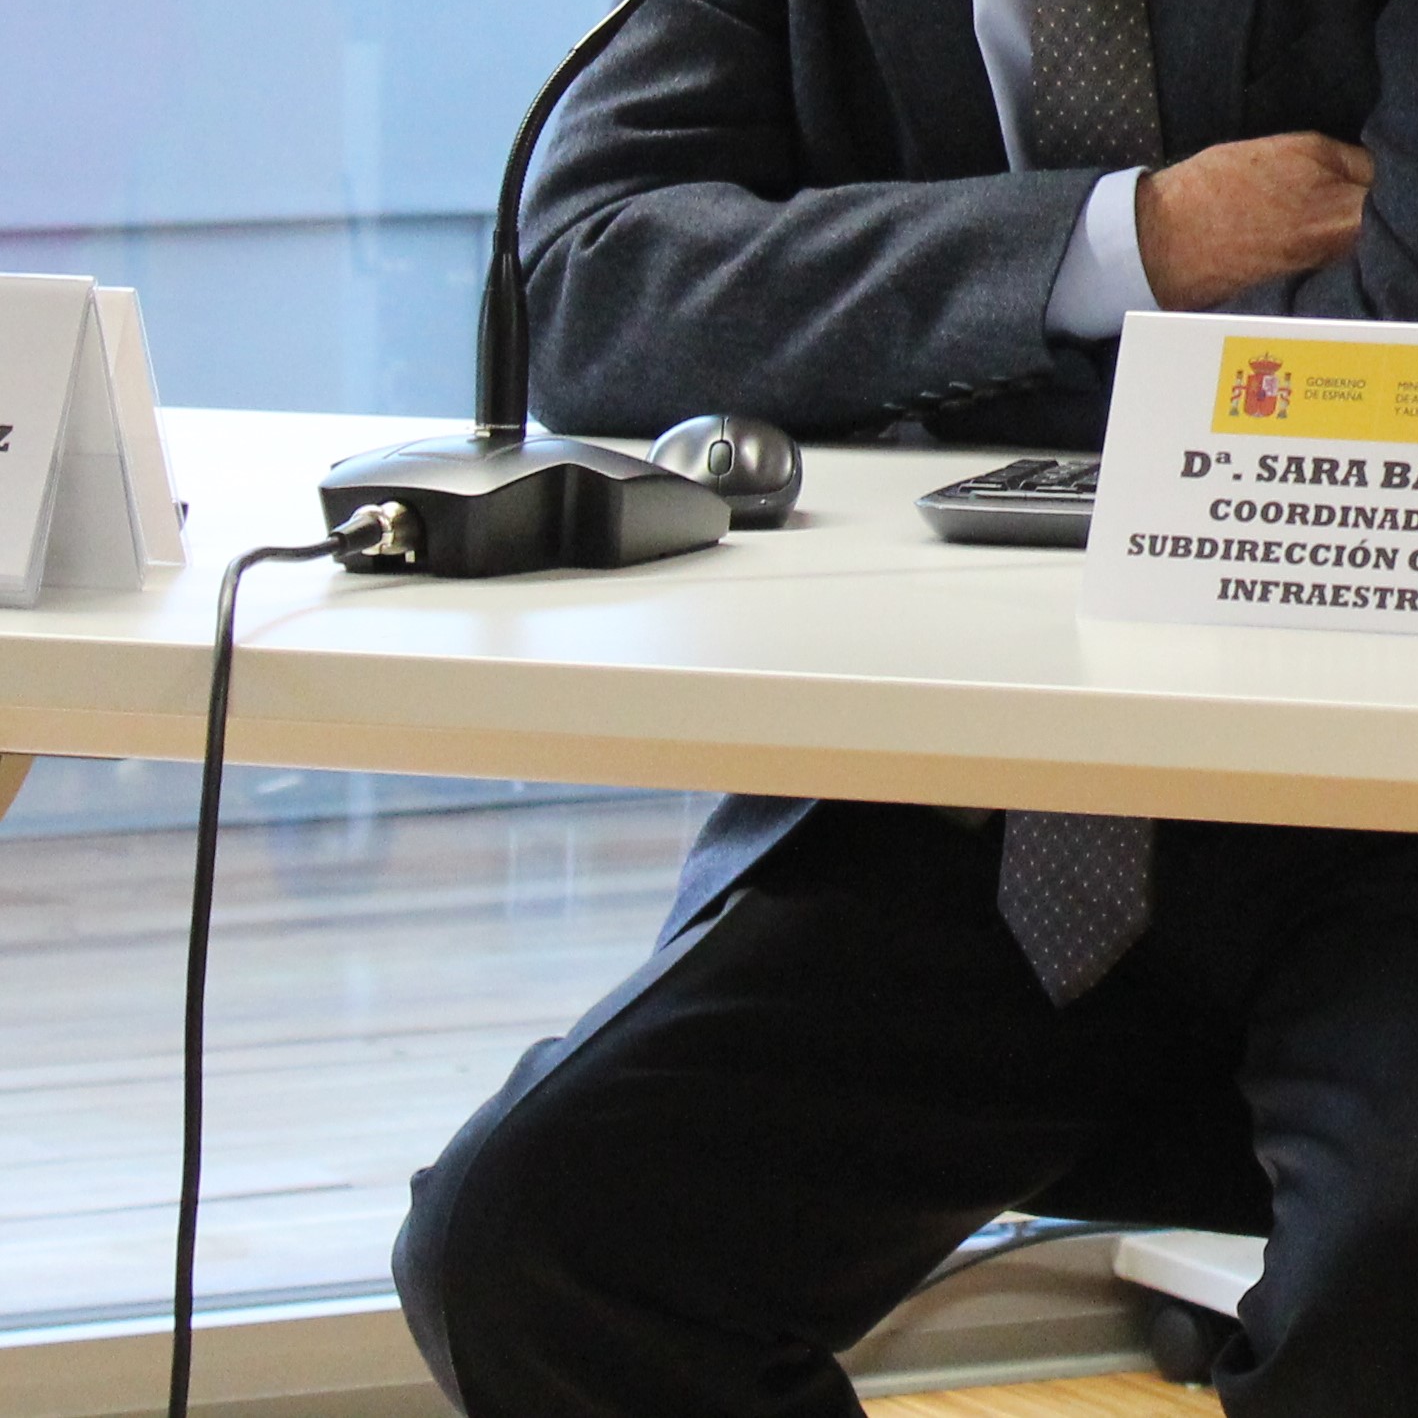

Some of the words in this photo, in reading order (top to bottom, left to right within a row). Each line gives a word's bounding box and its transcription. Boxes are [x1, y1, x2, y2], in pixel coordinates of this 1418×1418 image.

[1306, 377, 1366, 389] GOBIERNO
[1304, 390, 1319, 400] DE
[1322, 390, 1363, 401] ESPAÑA
[1395, 394, 1411, 404] DE
[1395, 408, 1401, 416] Y
[1256, 454, 1369, 488] SARA
[1127, 533, 1400, 571] SUBDIRECCIÓN
